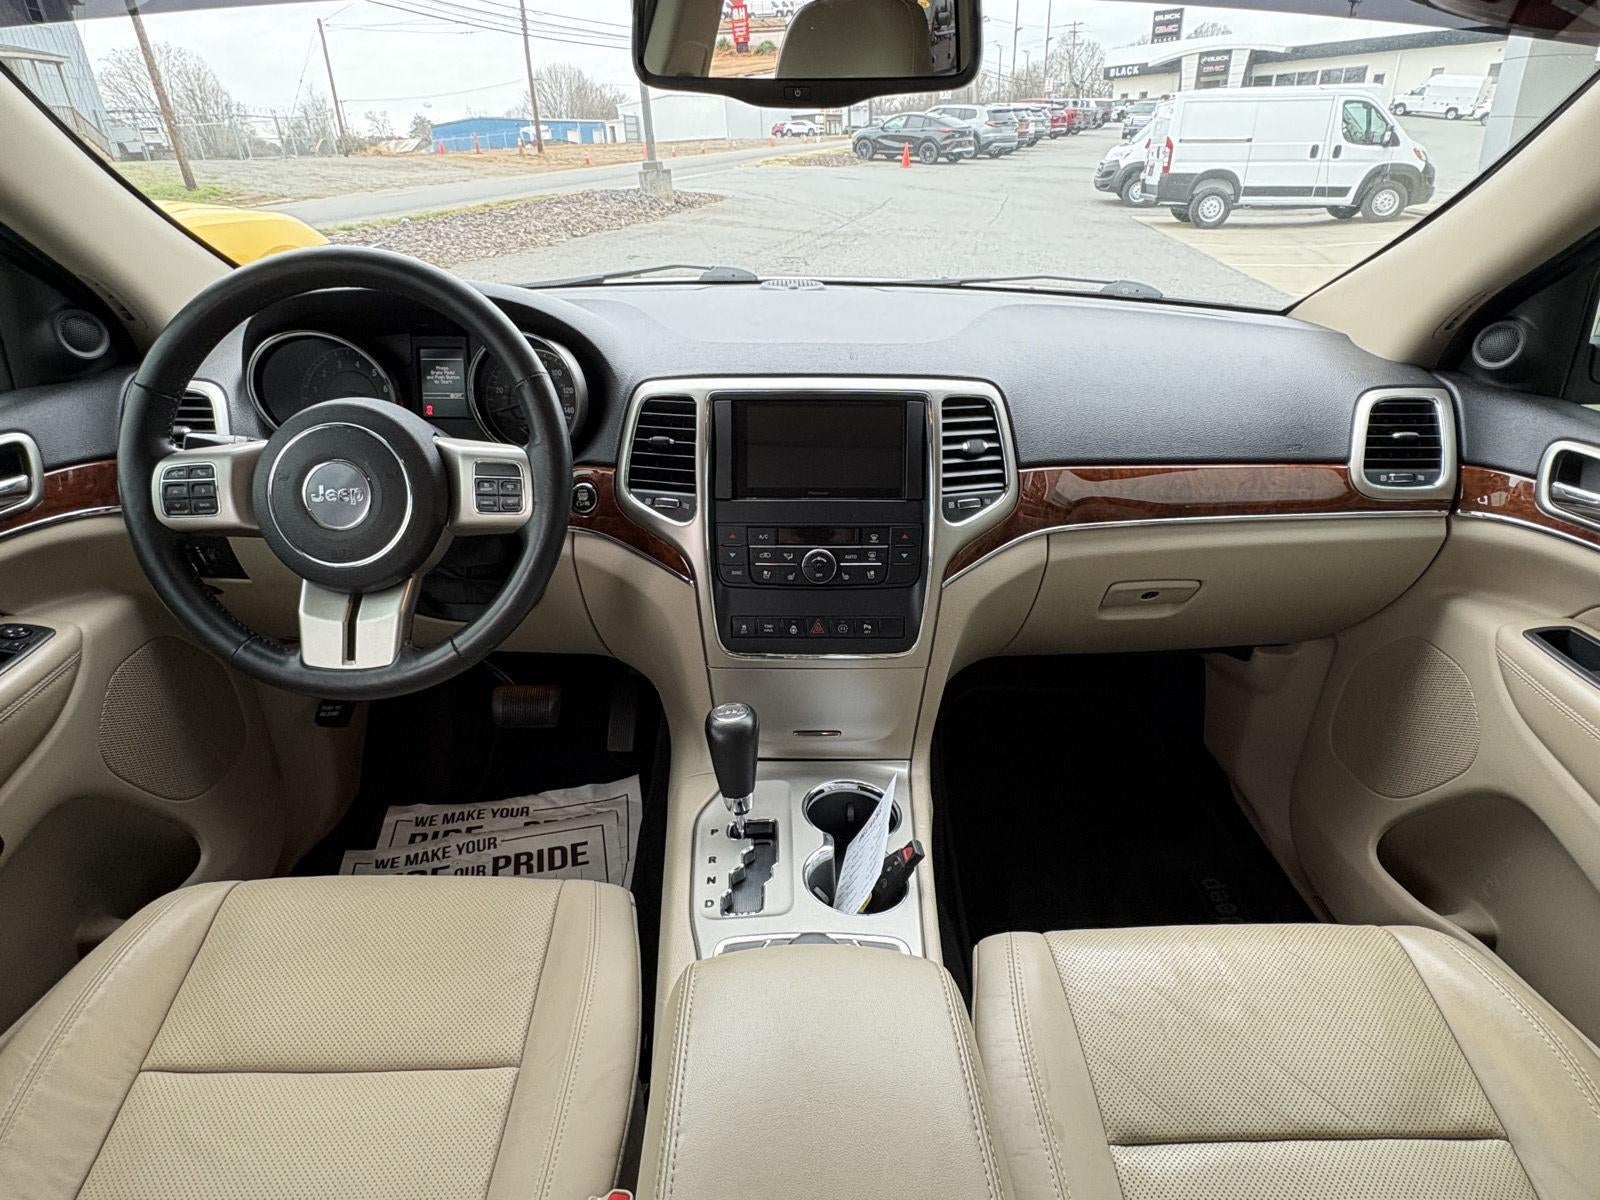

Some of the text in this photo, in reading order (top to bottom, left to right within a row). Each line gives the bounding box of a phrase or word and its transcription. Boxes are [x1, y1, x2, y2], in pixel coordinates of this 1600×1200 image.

[1154, 12, 1181, 22] BUICK
[1154, 24, 1179, 34] GMC
[1109, 65, 1139, 77] BLACK
[1202, 65, 1225, 73] GMC
[371, 369, 378, 377] 5
[383, 385, 388, 393] 6
[564, 406, 574, 414] 140
[310, 484, 364, 506] Jeep
[413, 806, 530, 828] WE MAKE YOUR
[710, 828, 719, 836] P
[373, 857, 399, 870] WE
[404, 846, 451, 866] MAKE
[455, 837, 498, 856] YOUR
[454, 864, 486, 876] OUR
[491, 840, 590, 876] PRIDE
[708, 856, 717, 864] R
[706, 876, 716, 884] N
[704, 899, 715, 908] D
